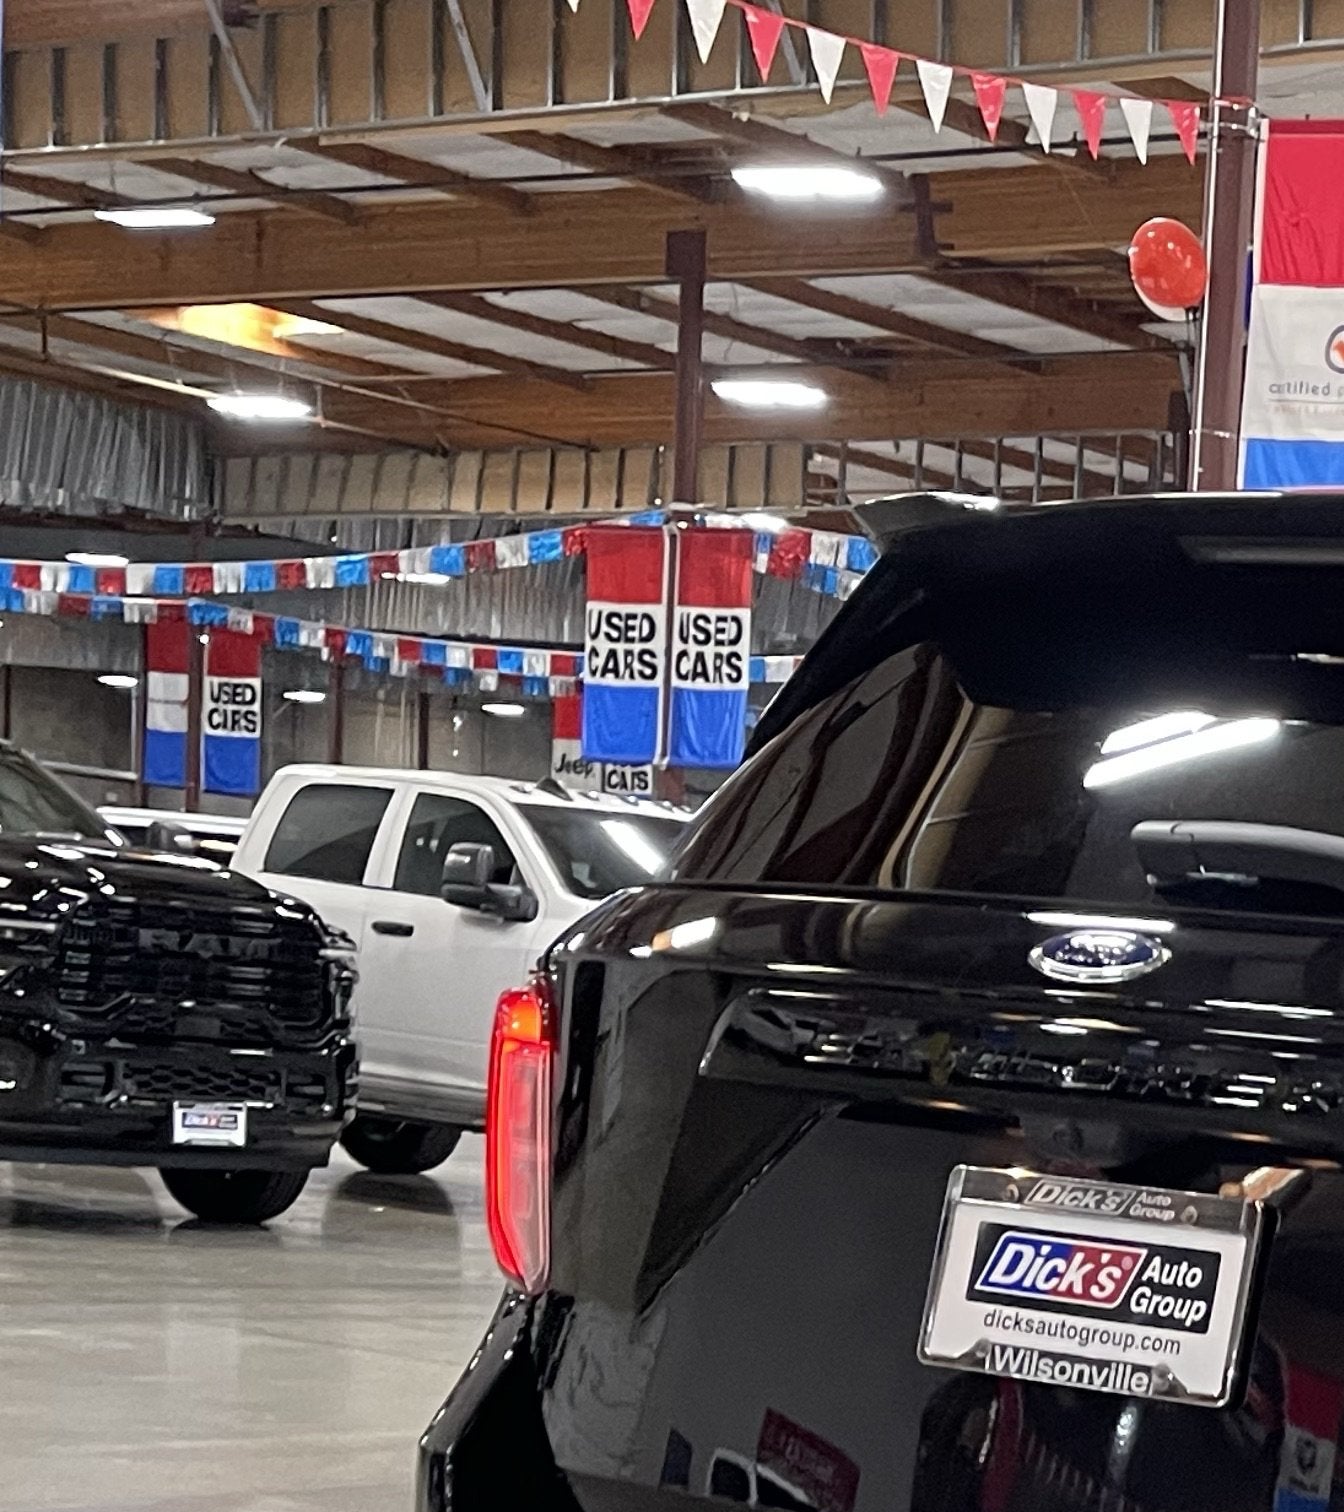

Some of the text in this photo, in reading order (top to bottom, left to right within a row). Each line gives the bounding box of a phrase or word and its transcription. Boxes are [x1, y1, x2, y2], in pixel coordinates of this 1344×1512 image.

[588, 609, 656, 643] USED
[679, 612, 743, 646] USED
[588, 647, 658, 680] CARS
[675, 649, 743, 683] CARS
[210, 680, 256, 706] USED
[1033, 1183, 1122, 1212] Dick's
[1130, 1203, 1176, 1222] Group
[1136, 1191, 1172, 1207] Auto
[988, 1243, 1122, 1299] Dick's
[1141, 1255, 1203, 1289] Auto
[1129, 1285, 1208, 1328] Group
[983, 1309, 1181, 1356] dicksautogroup.com
[993, 1344, 1150, 1393] Wilsonville
